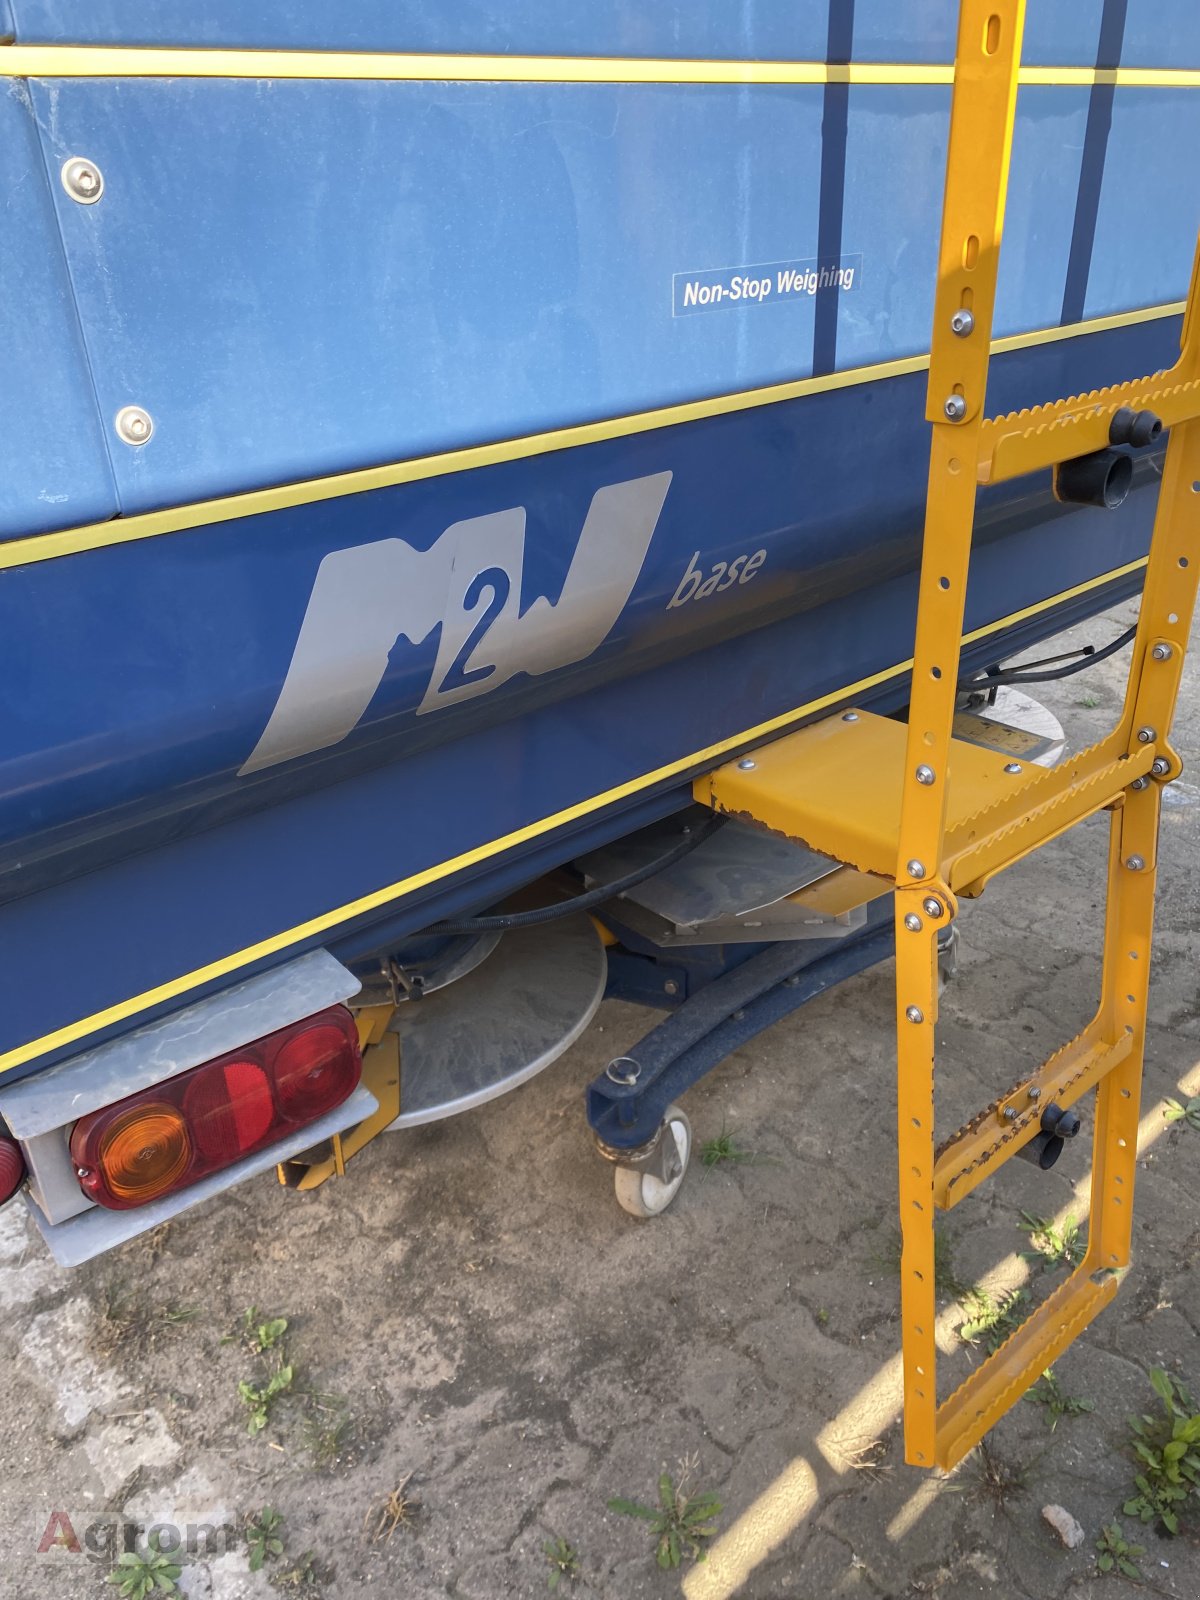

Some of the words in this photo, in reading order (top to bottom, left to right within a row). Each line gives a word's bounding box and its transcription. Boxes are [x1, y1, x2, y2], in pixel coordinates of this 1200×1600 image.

[683, 278, 772, 307] Non-Stop
[777, 265, 855, 295] Weighing
[666, 548, 767, 610] base
